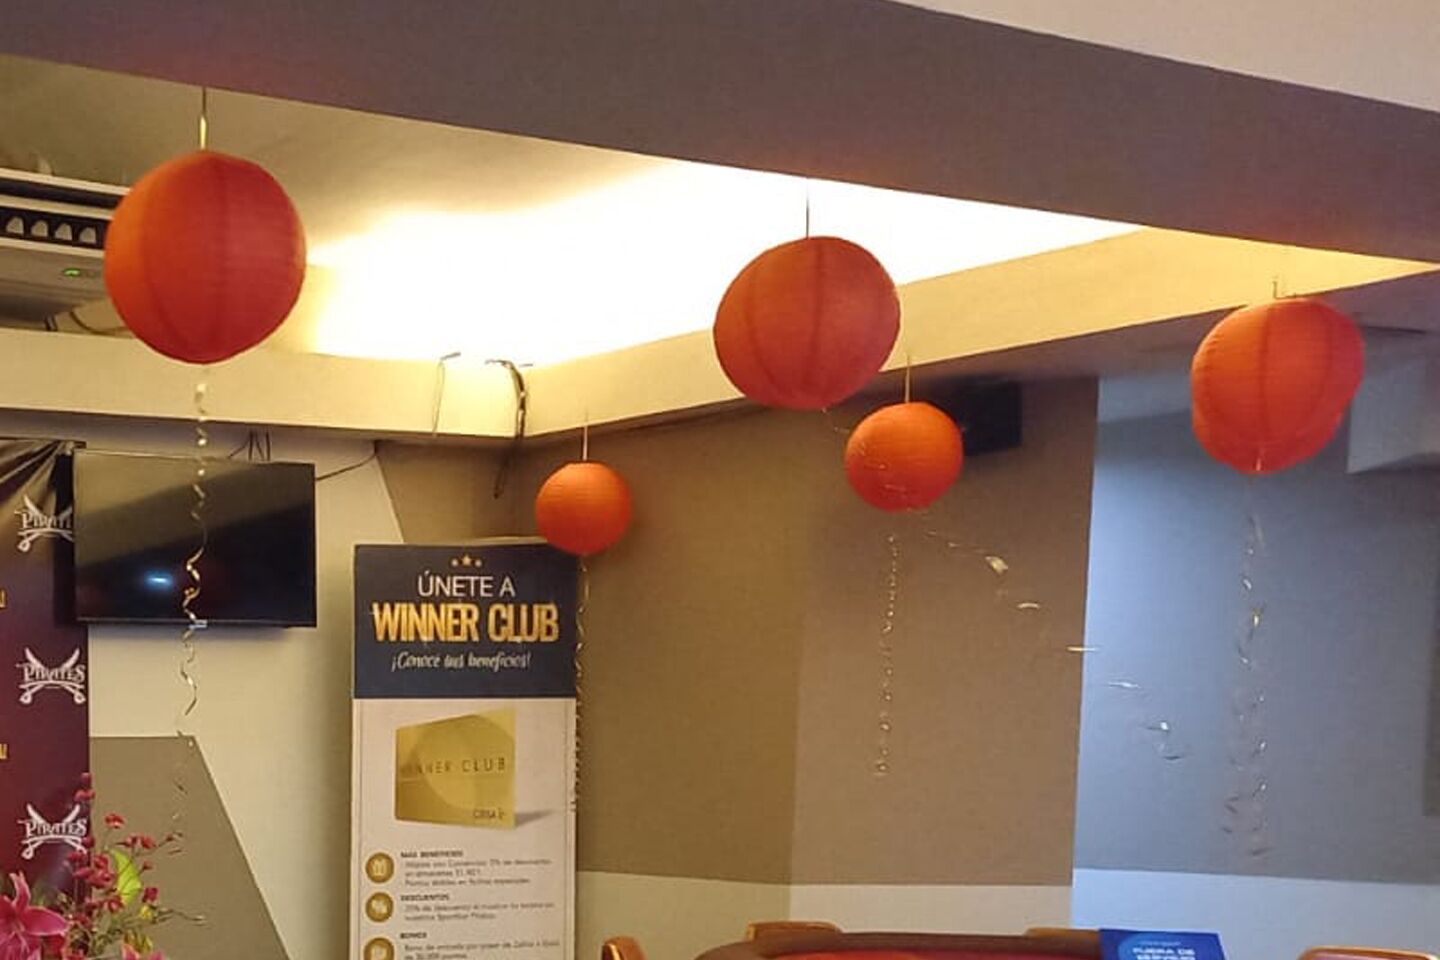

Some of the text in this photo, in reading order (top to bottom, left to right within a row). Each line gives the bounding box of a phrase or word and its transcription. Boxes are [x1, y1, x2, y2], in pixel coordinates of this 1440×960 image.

[418, 570, 516, 598] ÚNETE A
[371, 602, 559, 643] WINNER CLUB
